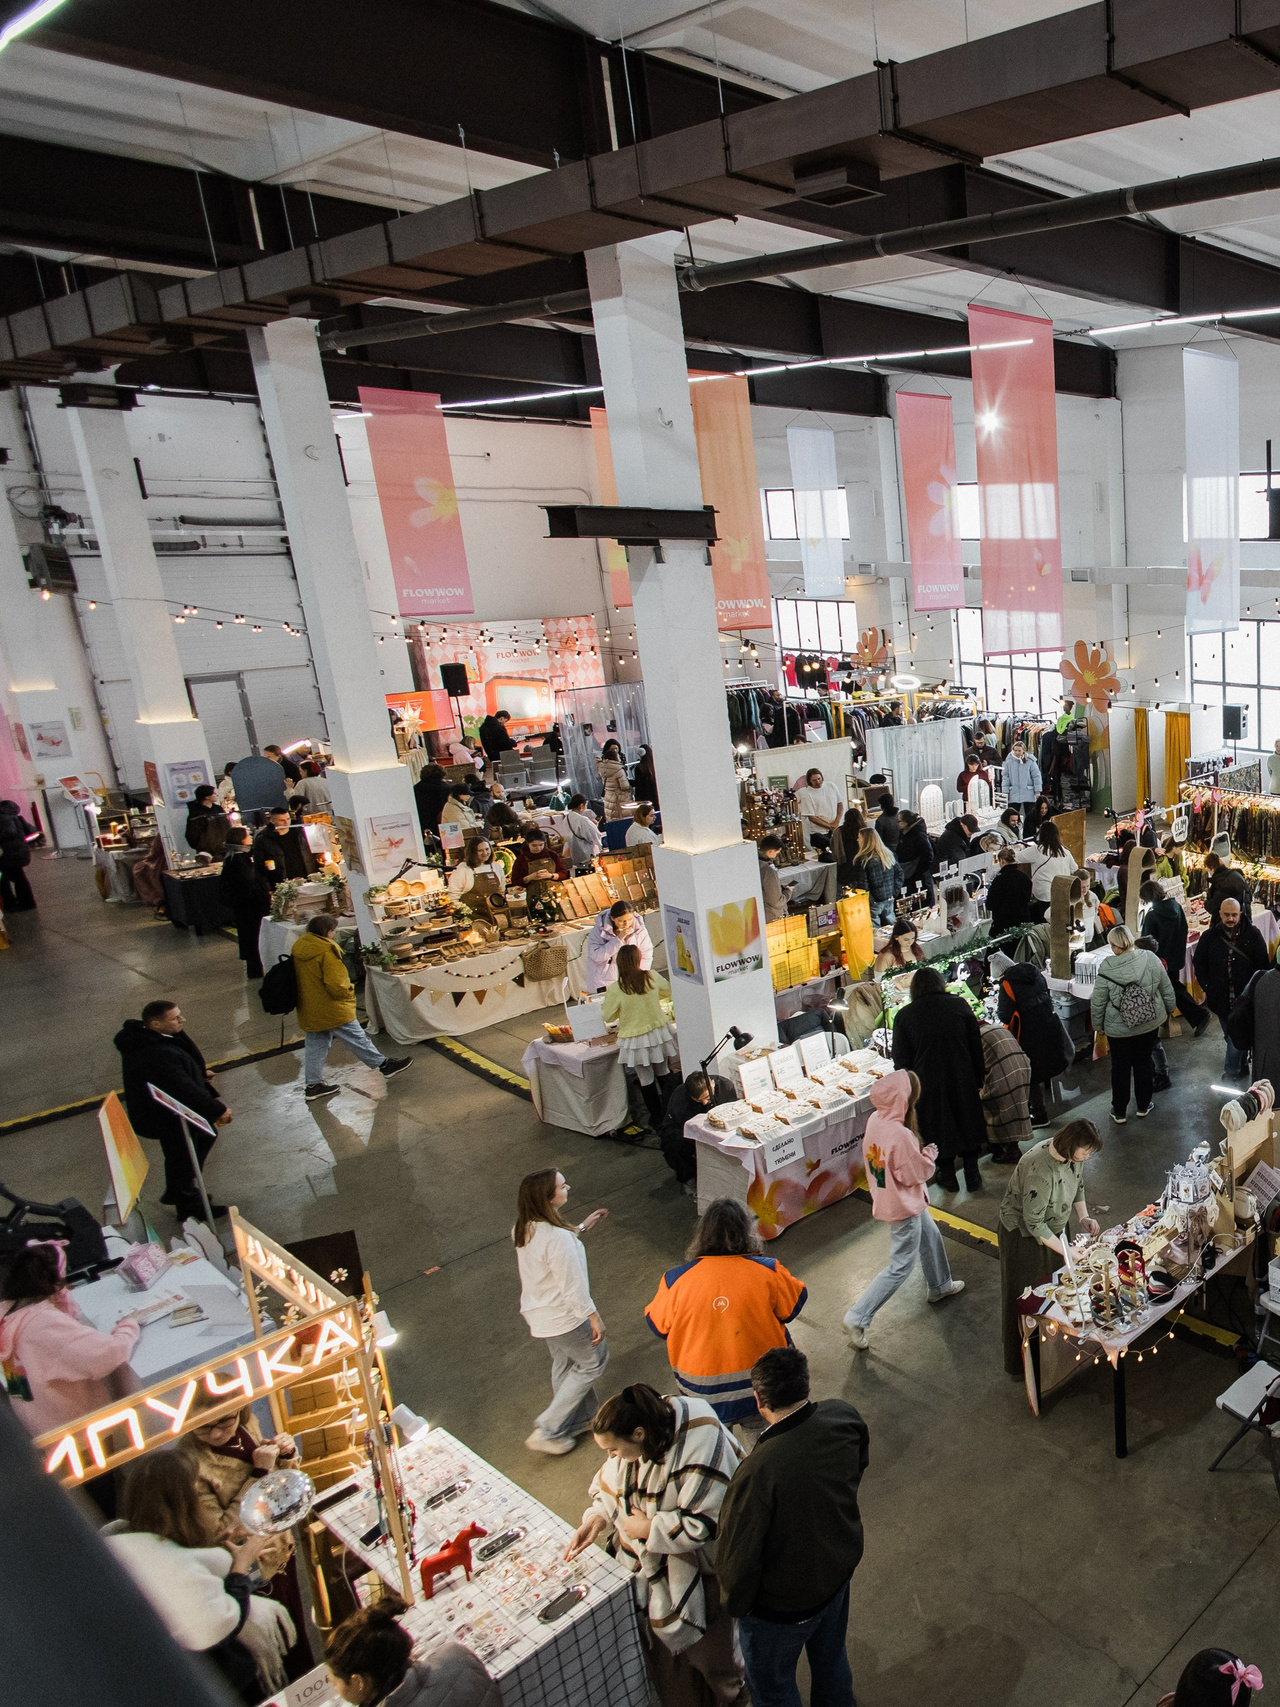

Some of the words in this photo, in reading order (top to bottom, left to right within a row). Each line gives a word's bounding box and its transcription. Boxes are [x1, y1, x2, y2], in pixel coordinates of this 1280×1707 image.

[402, 587, 465, 598] FLOWWOW
[917, 583, 960, 593] FLOWWOW
[421, 597, 451, 605] market
[715, 598, 764, 610] OWWOW
[716, 954, 760, 974] FLOWWOW
